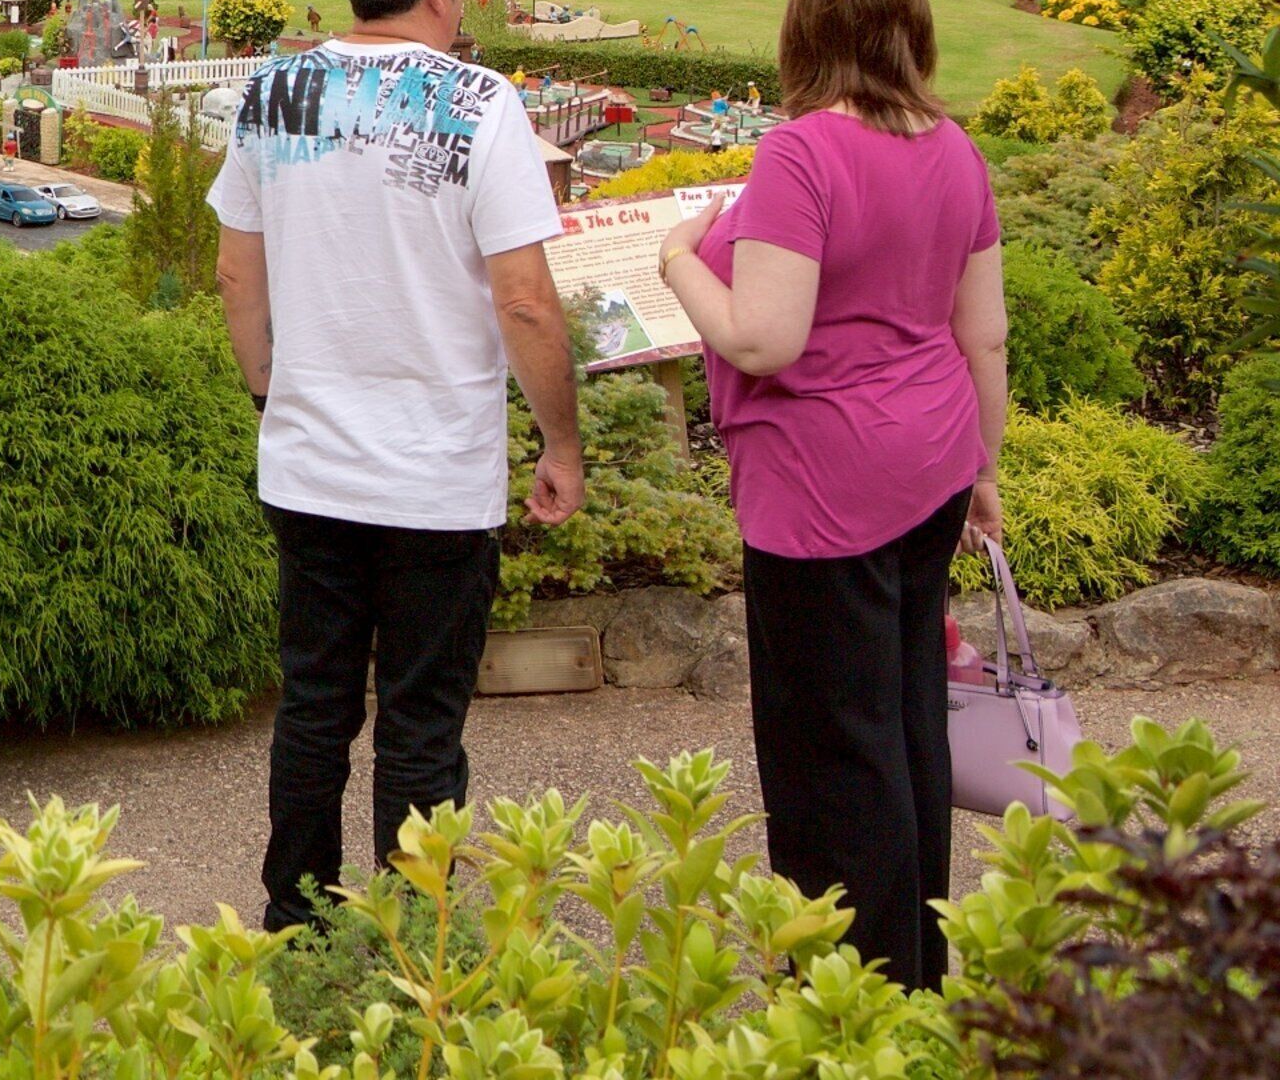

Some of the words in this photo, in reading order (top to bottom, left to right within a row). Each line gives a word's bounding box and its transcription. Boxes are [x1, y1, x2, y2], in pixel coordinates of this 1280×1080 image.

[680, 191, 702, 200] Fun
[706, 189, 736, 199] Fcts
[585, 215, 614, 229] The
[618, 209, 650, 224] City
